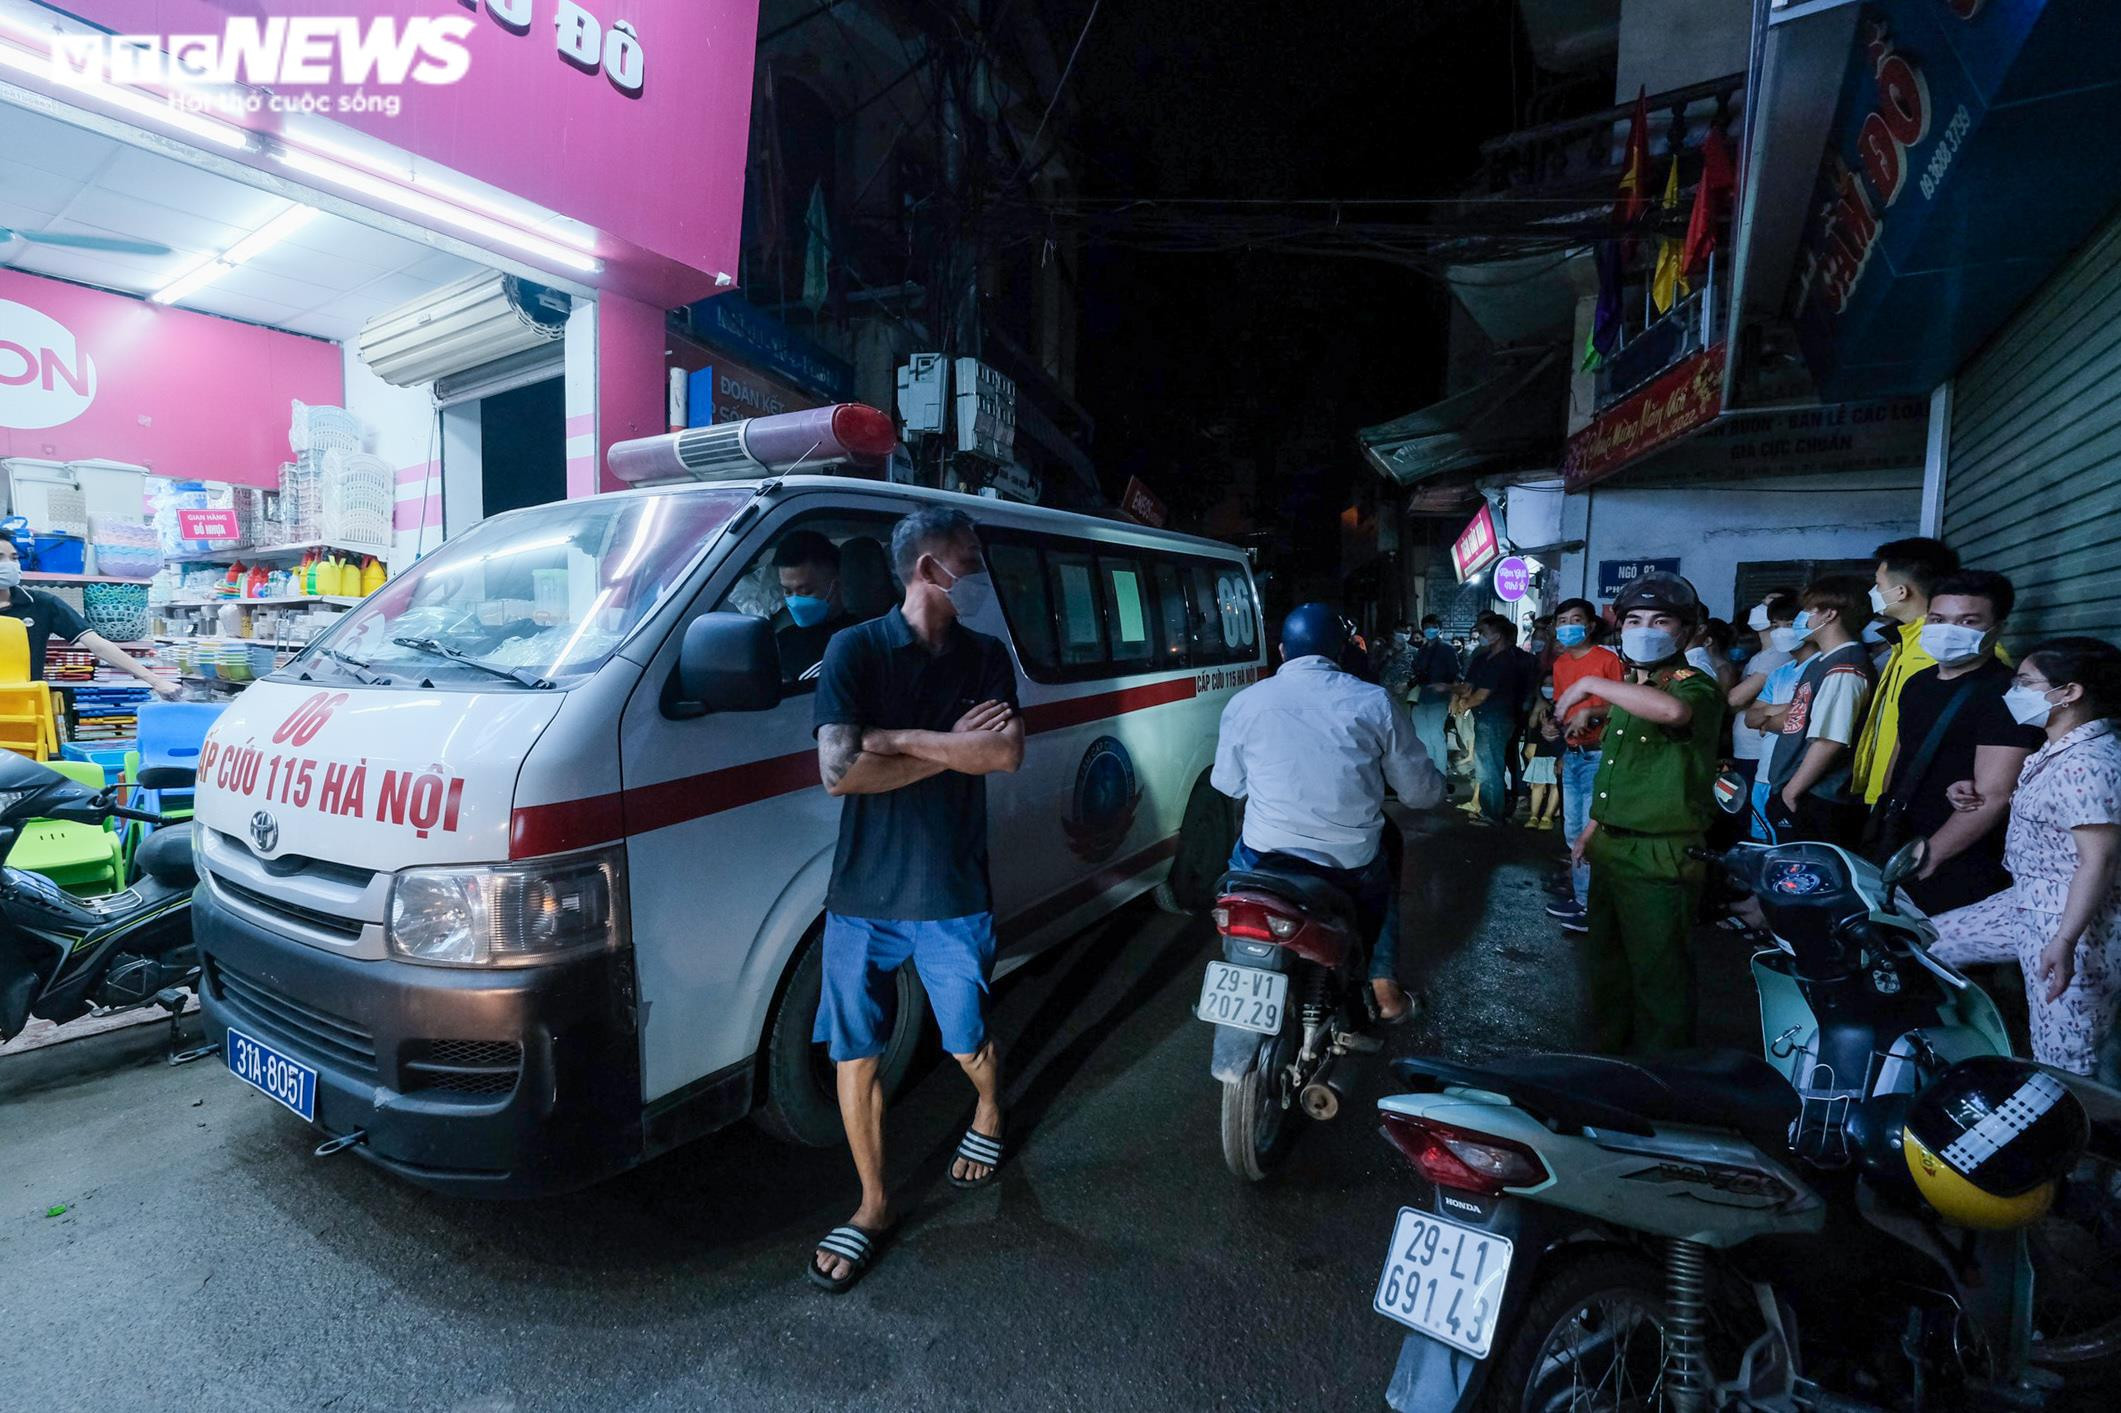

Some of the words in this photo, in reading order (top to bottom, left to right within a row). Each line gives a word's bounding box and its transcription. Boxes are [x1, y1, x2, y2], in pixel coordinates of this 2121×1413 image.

[554, 0, 644, 99] ĐÔ
[272, 691, 349, 747] 06
[197, 727, 219, 783] ẤP
[217, 736, 264, 796] CỨU
[265, 754, 317, 808] 115
[318, 757, 367, 818] HÀ
[375, 762, 465, 839] NỘI
[1206, 992, 1277, 1029] 207.29
[1444, 1196, 1482, 1215] HONDA
[1404, 1220, 1490, 1286] 29-L1
